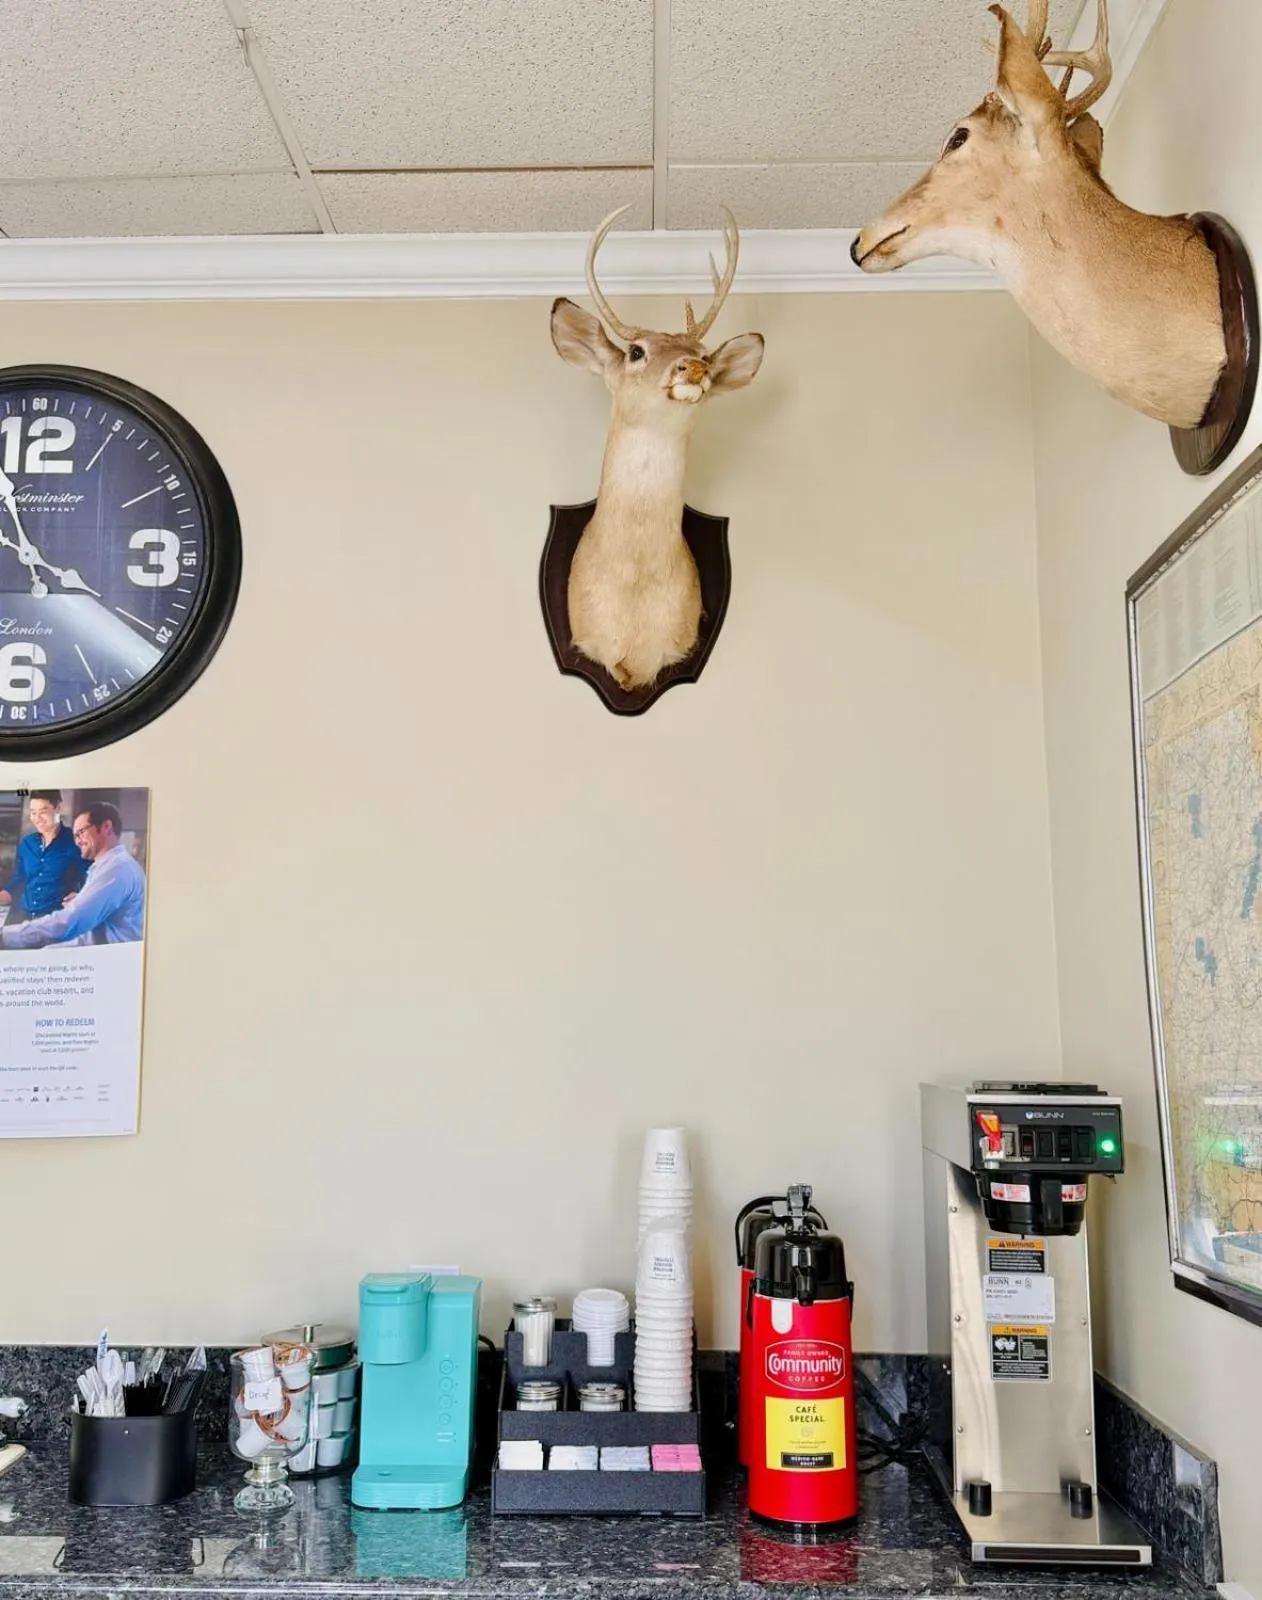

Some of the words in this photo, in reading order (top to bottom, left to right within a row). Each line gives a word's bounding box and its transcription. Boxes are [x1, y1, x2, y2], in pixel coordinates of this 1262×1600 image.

[32, 397, 48, 411] 60
[112, 419, 124, 432] 5
[1, 416, 76, 474] 12
[163, 473, 181, 491] 10
[127, 528, 181, 588] 3
[183, 551, 197, 566] 15
[0, 618, 53, 635] London
[155, 626, 173, 644] 20
[0, 642, 47, 702] 6
[93, 683, 111, 702] 25
[10, 705, 27, 720] 30
[6, 989, 36, 997] vacation
[53, 987, 79, 995] resorts,
[36, 1019, 53, 1027] HOW
[1033, 1111, 1065, 1119] BUNN
[768, 1353, 842, 1375] Community
[796, 1404, 817, 1413] CAFÉ
[789, 1415, 824, 1423] SPECIAL
